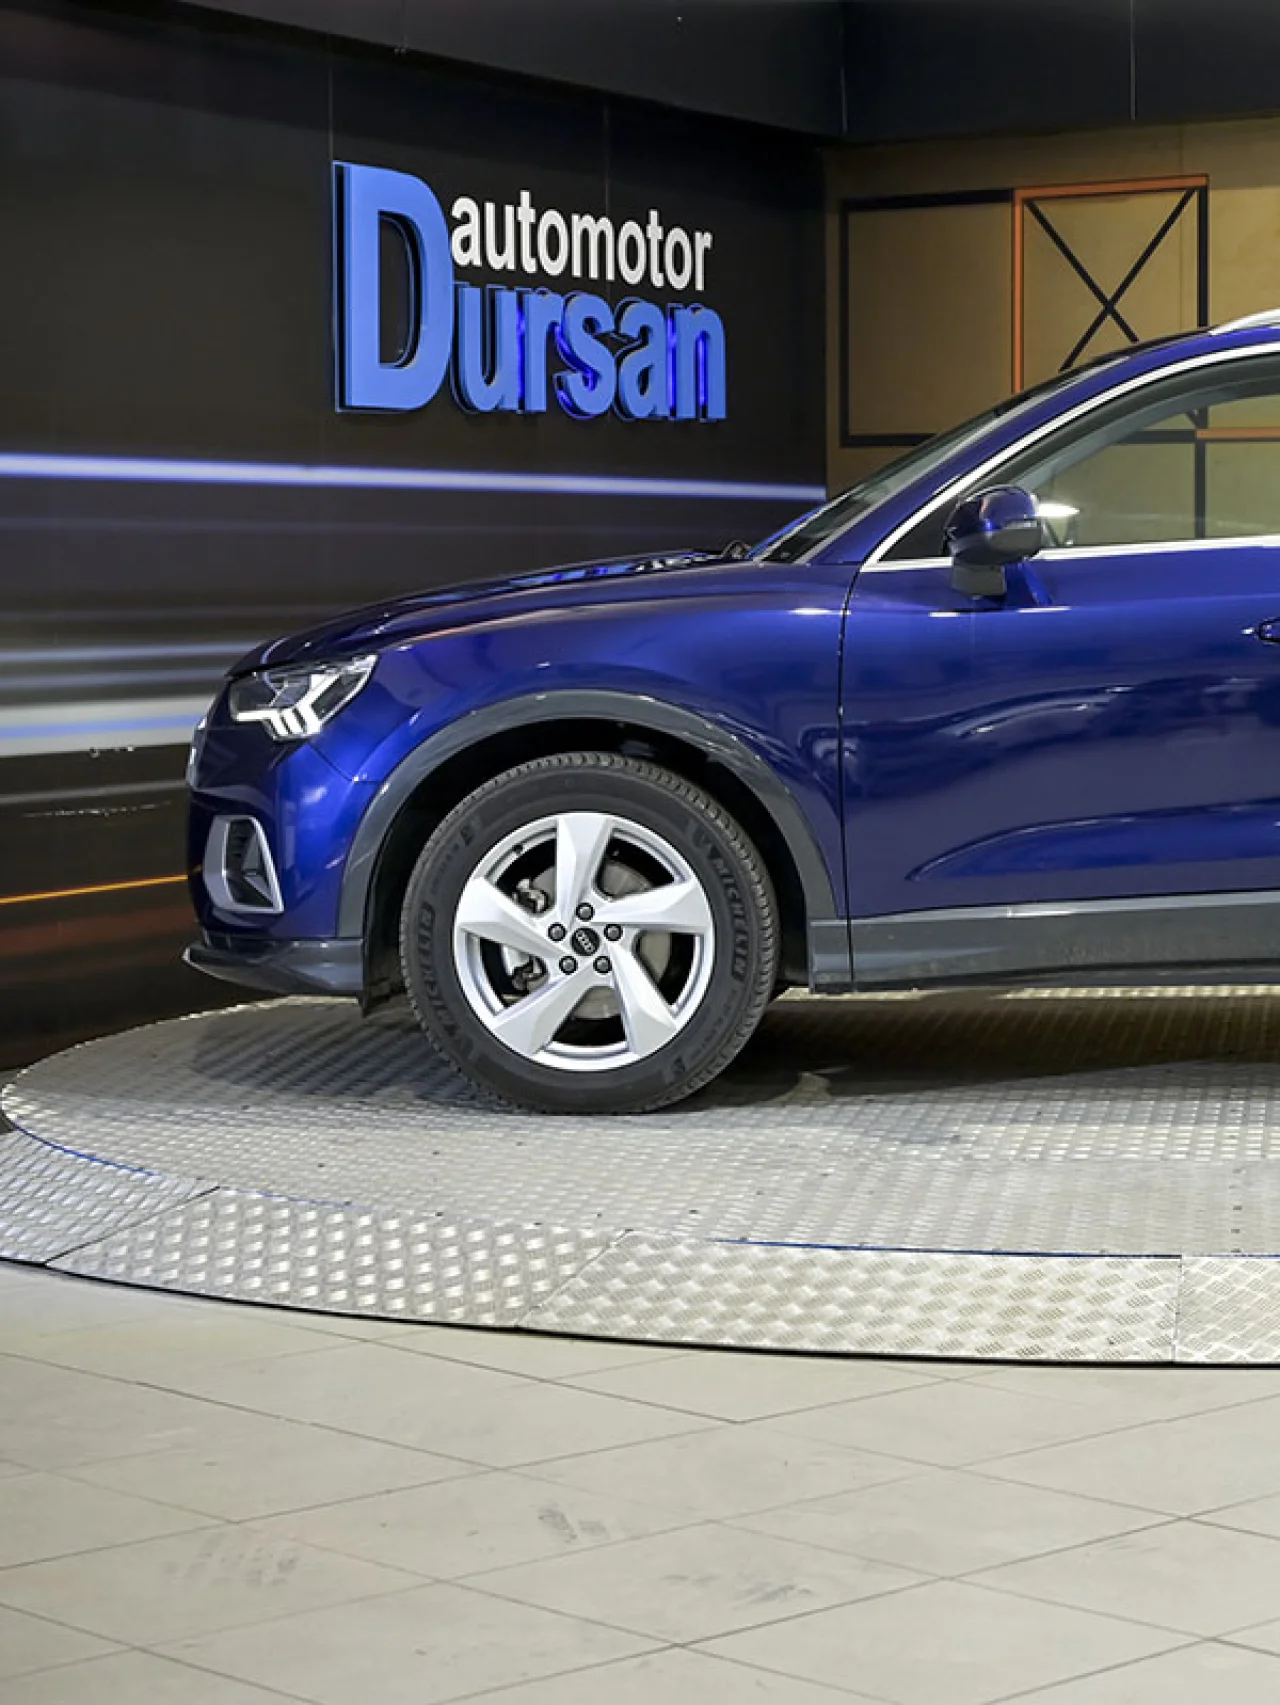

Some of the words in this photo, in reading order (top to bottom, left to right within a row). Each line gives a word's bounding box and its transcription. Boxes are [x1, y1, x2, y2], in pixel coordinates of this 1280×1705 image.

[333, 160, 727, 422] Dursan
[451, 189, 713, 291] automotor
[711, 856, 748, 979] MICHELIN
